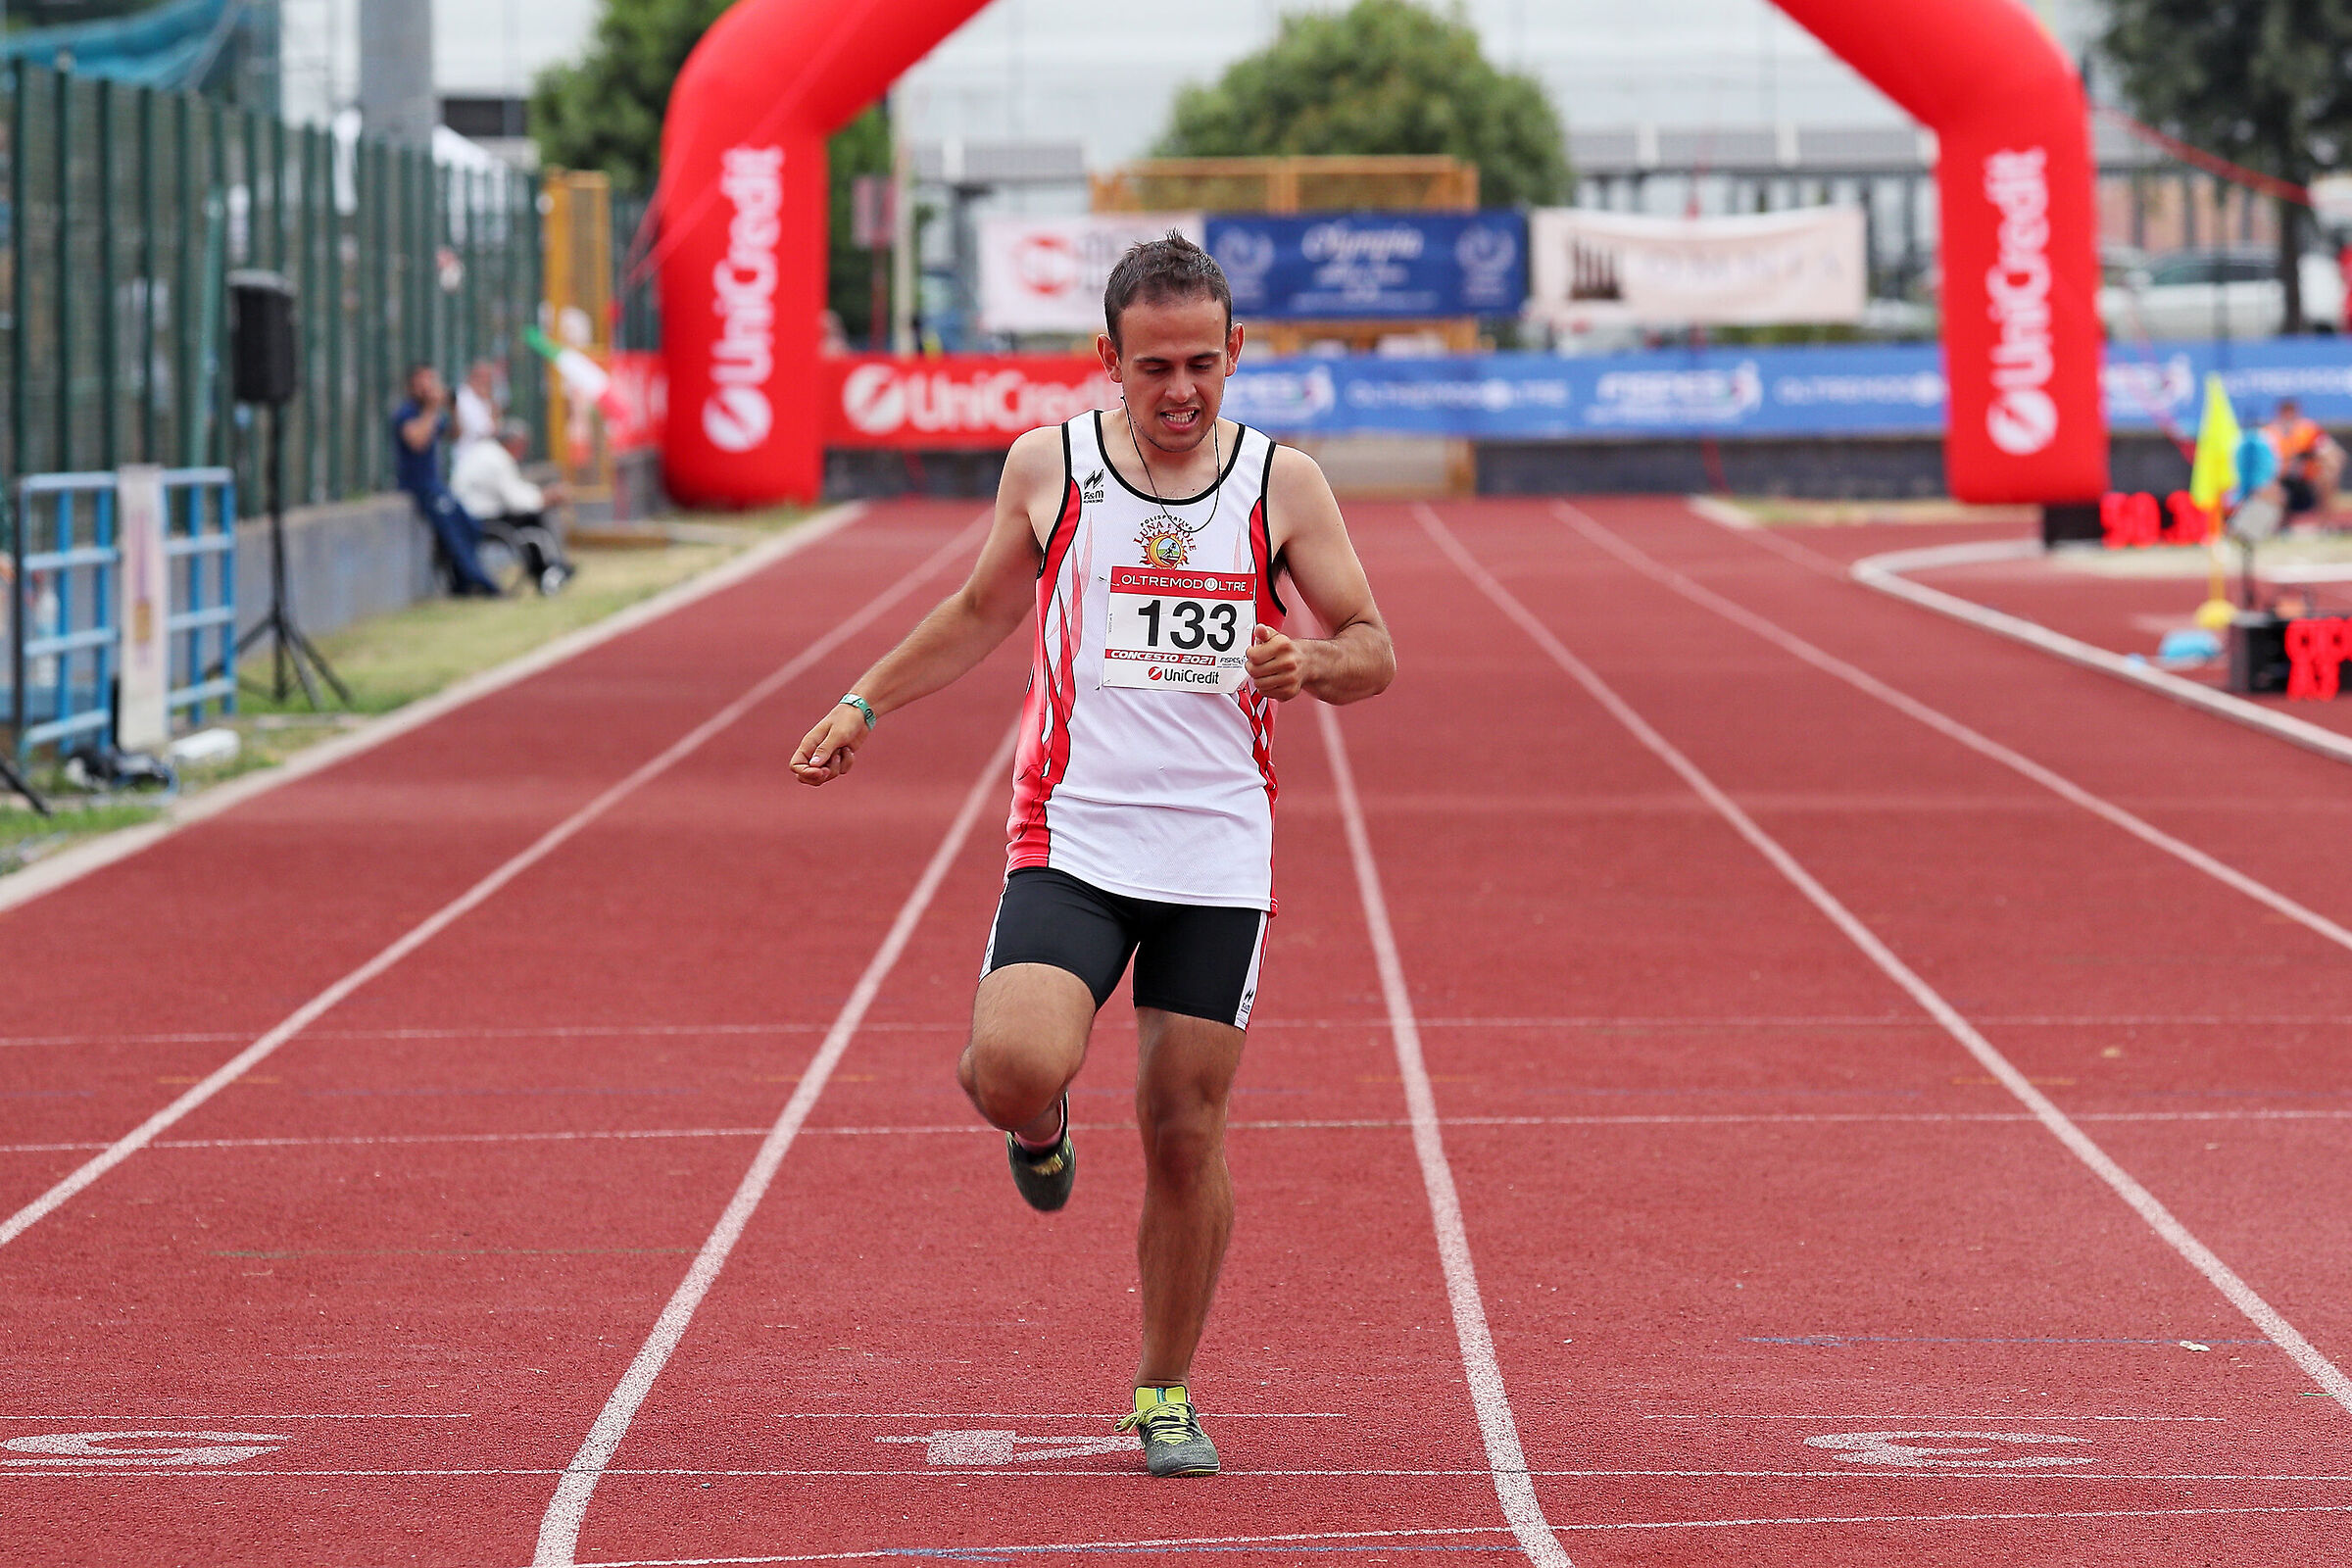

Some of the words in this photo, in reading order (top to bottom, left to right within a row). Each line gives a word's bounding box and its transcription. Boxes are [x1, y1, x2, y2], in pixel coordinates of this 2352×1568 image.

[710, 145, 785, 385] UniCredit
[1984, 146, 2054, 390] UniCredit
[1132, 520, 1164, 545] LUNA
[1138, 599, 1238, 653] 133
[1110, 650, 1180, 662] CONCESIO
[1181, 655, 1215, 665] 2021
[1164, 668, 1220, 685] UniCredit
